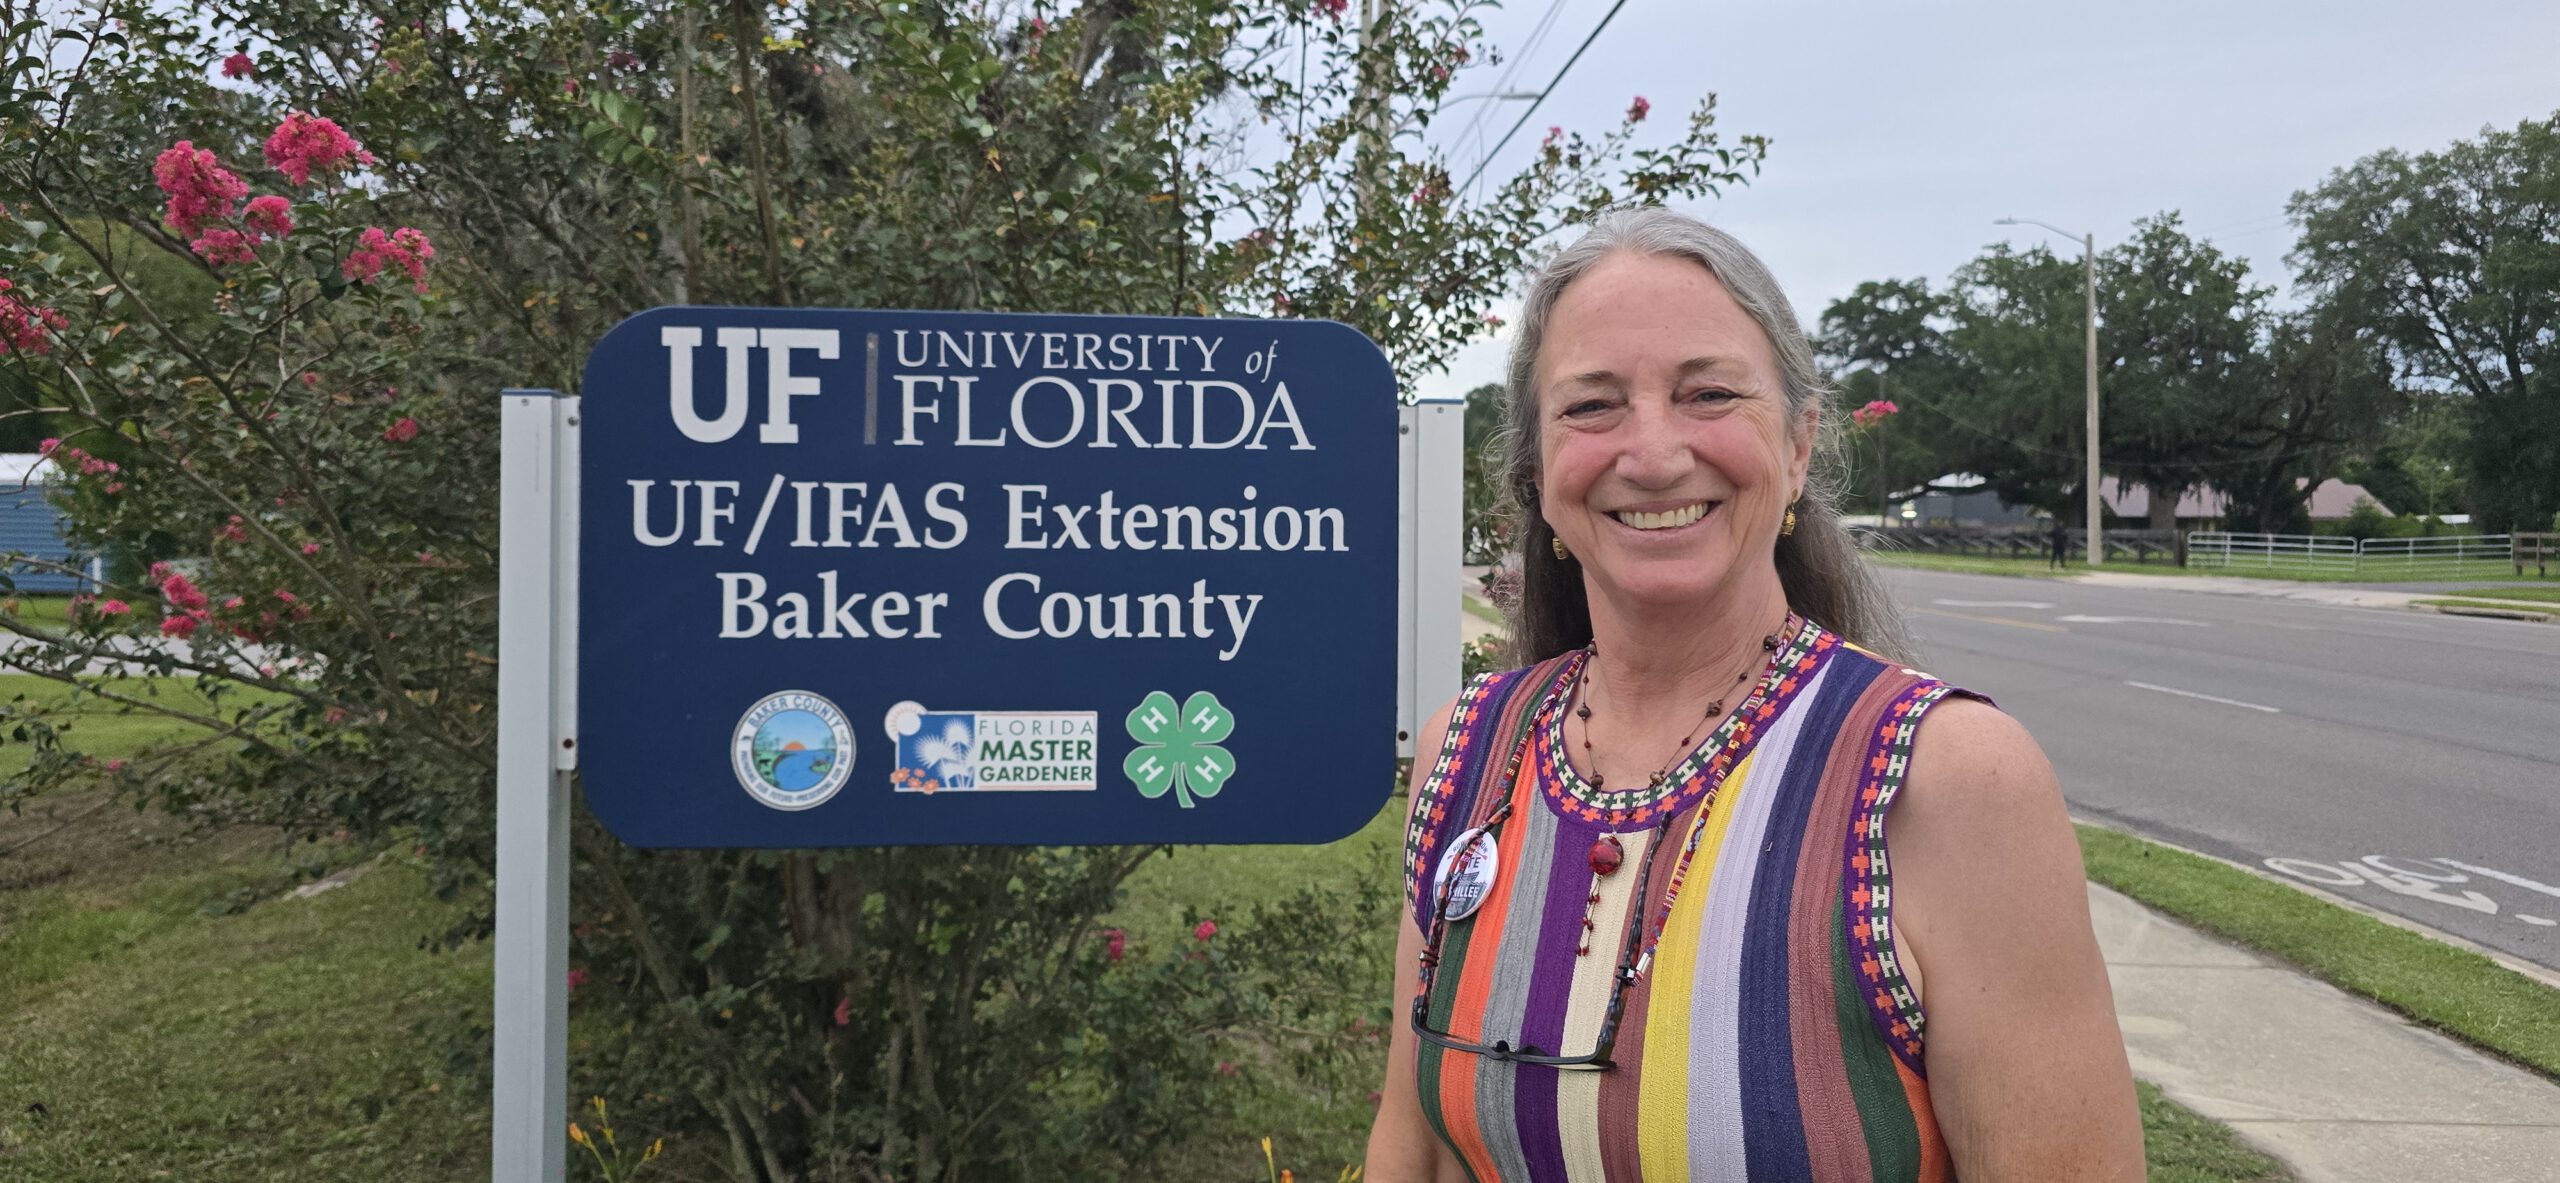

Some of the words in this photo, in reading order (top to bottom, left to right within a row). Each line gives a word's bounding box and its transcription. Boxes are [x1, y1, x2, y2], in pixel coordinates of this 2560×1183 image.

[894, 330, 1223, 372] UNIVERSITY
[1245, 339, 1279, 383] of
[662, 326, 839, 443] UF
[893, 375, 1316, 450] FLORIDA
[627, 474, 968, 556] UF/IFAS
[1002, 484, 1349, 552] Extension
[716, 570, 949, 640] Baker
[983, 572, 1264, 662] County
[748, 697, 788, 727] BAKER
[793, 696, 844, 728] COUNTY
[979, 720, 1095, 736] FLORIDA
[1141, 706, 1169, 733] H
[1192, 706, 1219, 733] H
[979, 740, 1093, 762] MASTER
[979, 766, 1093, 782] GARDENER
[1137, 755, 1165, 783] H
[1194, 755, 1222, 783] H
